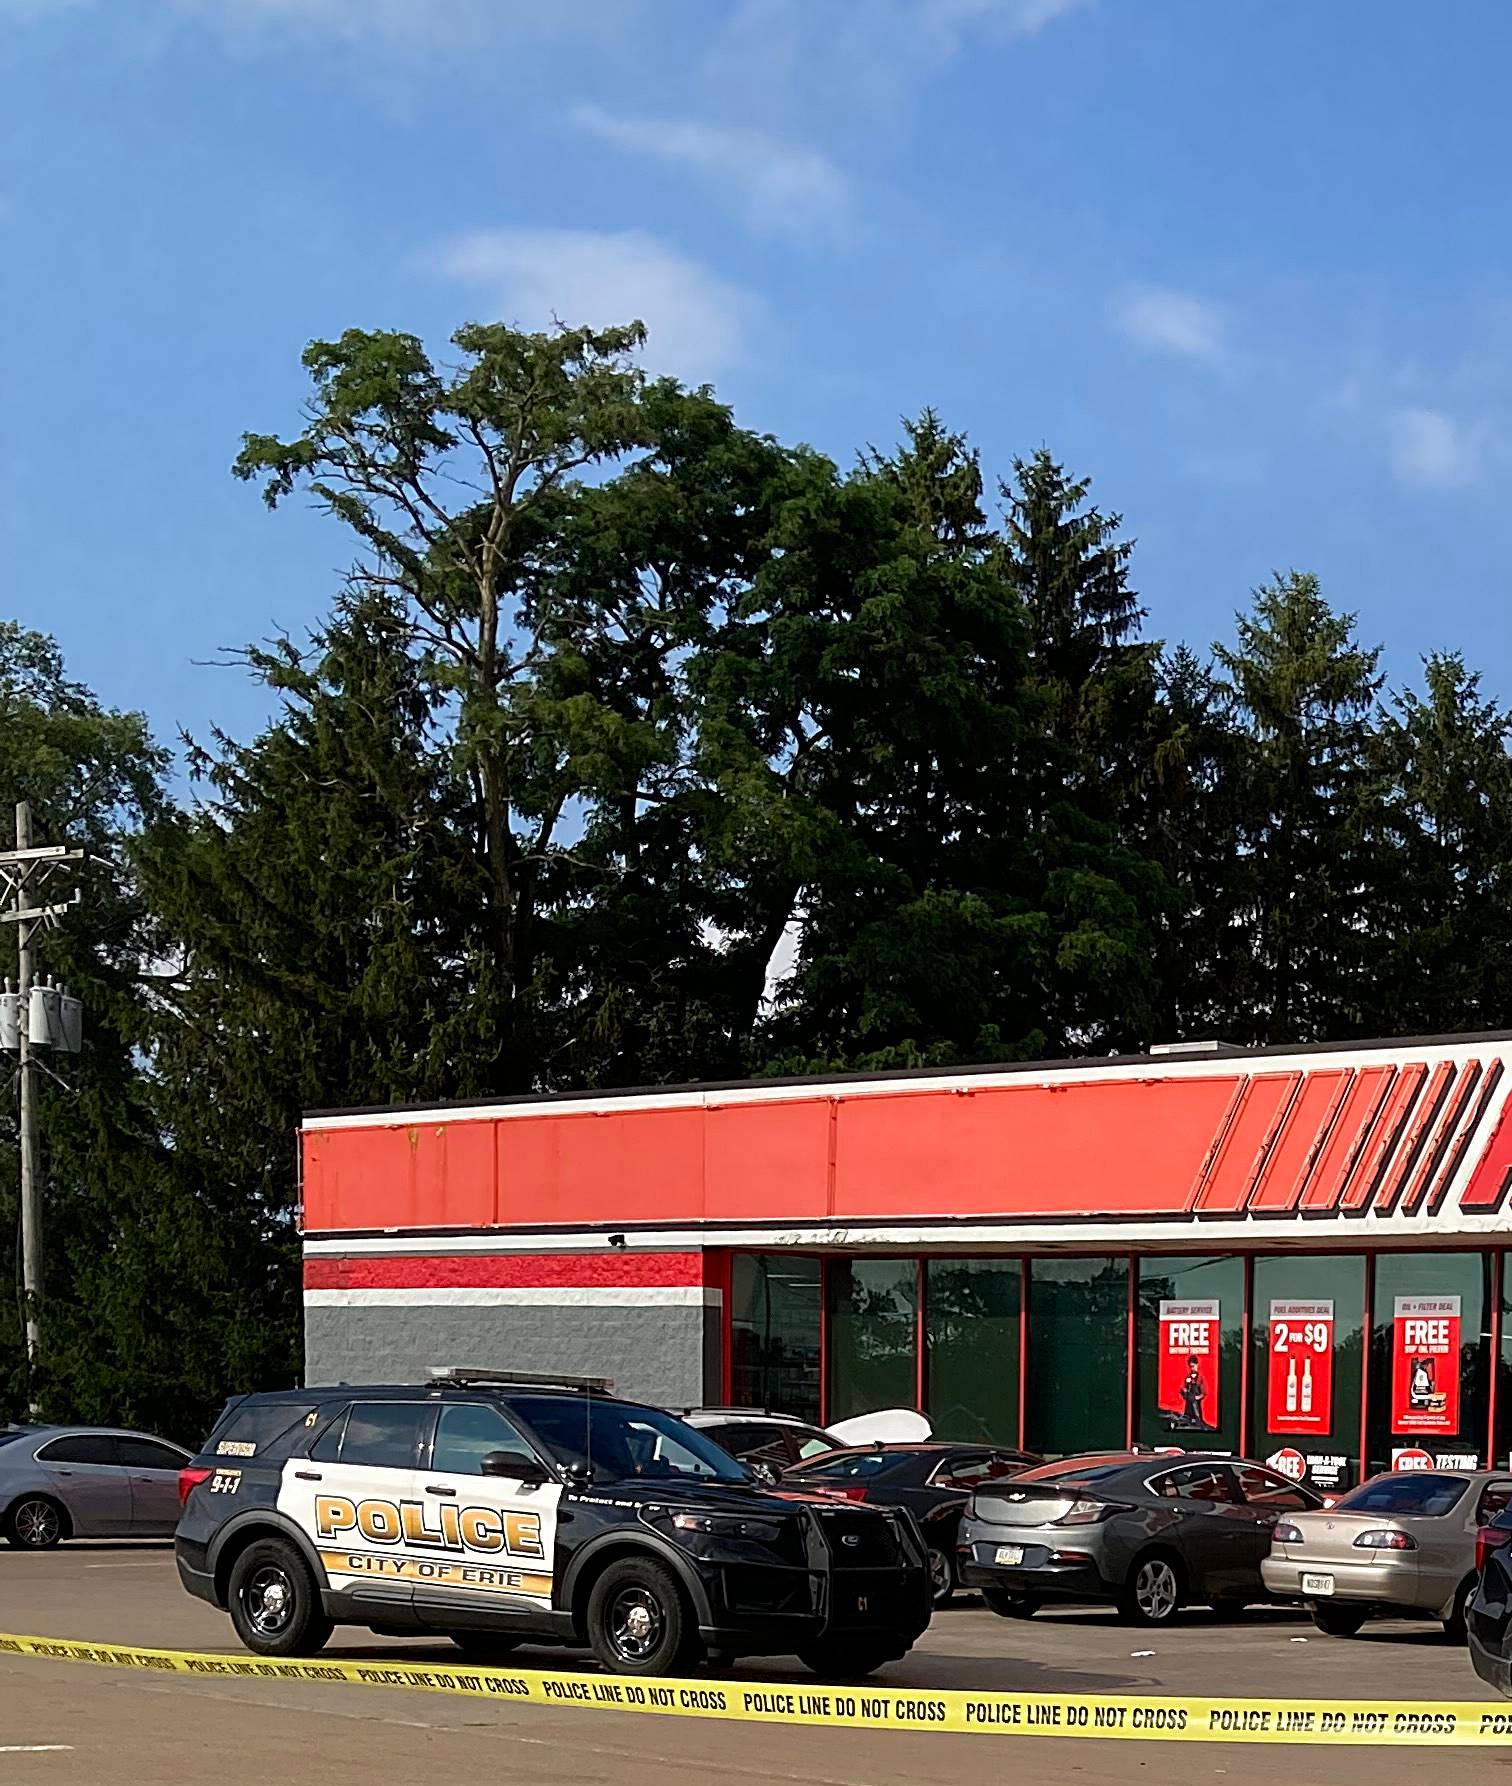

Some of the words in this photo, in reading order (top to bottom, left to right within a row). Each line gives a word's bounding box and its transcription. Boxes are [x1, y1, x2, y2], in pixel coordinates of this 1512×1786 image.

[1169, 1322, 1209, 1346] FREE
[1273, 1323, 1289, 1353] 2
[1304, 1322, 1328, 1353] $9
[1405, 1320, 1449, 1345] FREE
[1277, 1456, 1301, 1478] REE
[210, 1475, 241, 1494] 9-1-1
[315, 1494, 545, 1560] POLICE
[348, 1555, 407, 1573] CITY
[418, 1563, 452, 1579] OF
[462, 1569, 523, 1588] ERIE
[184, 1660, 228, 1673] POLICE
[277, 1666, 303, 1679] NOT
[357, 1669, 405, 1685] POLICE
[405, 1672, 436, 1687] LINE
[434, 1674, 456, 1689] DO
[455, 1676, 483, 1691] NOT
[485, 1678, 529, 1695] CROSS
[542, 1681, 591, 1700] POLICE
[592, 1684, 624, 1703] LINE
[625, 1686, 645, 1704] DO
[648, 1688, 676, 1707] NOT
[680, 1690, 726, 1710] CROSS
[744, 1693, 795, 1713] POLICE
[799, 1696, 831, 1715] LINE
[836, 1698, 855, 1717] DO
[861, 1699, 890, 1719] NOT
[896, 1700, 946, 1721] CROSS
[966, 1703, 1021, 1723] POLICE
[1027, 1705, 1061, 1725] LINE
[1067, 1706, 1088, 1726] DO
[1095, 1707, 1127, 1727] NOT
[1132, 1708, 1188, 1729] CROSS
[1209, 1710, 1271, 1731] POLICE
[1276, 1711, 1315, 1732] LINE
[1320, 1712, 1346, 1732] DO
[1352, 1713, 1389, 1733] NOT
[1394, 1714, 1457, 1734] CROSS
